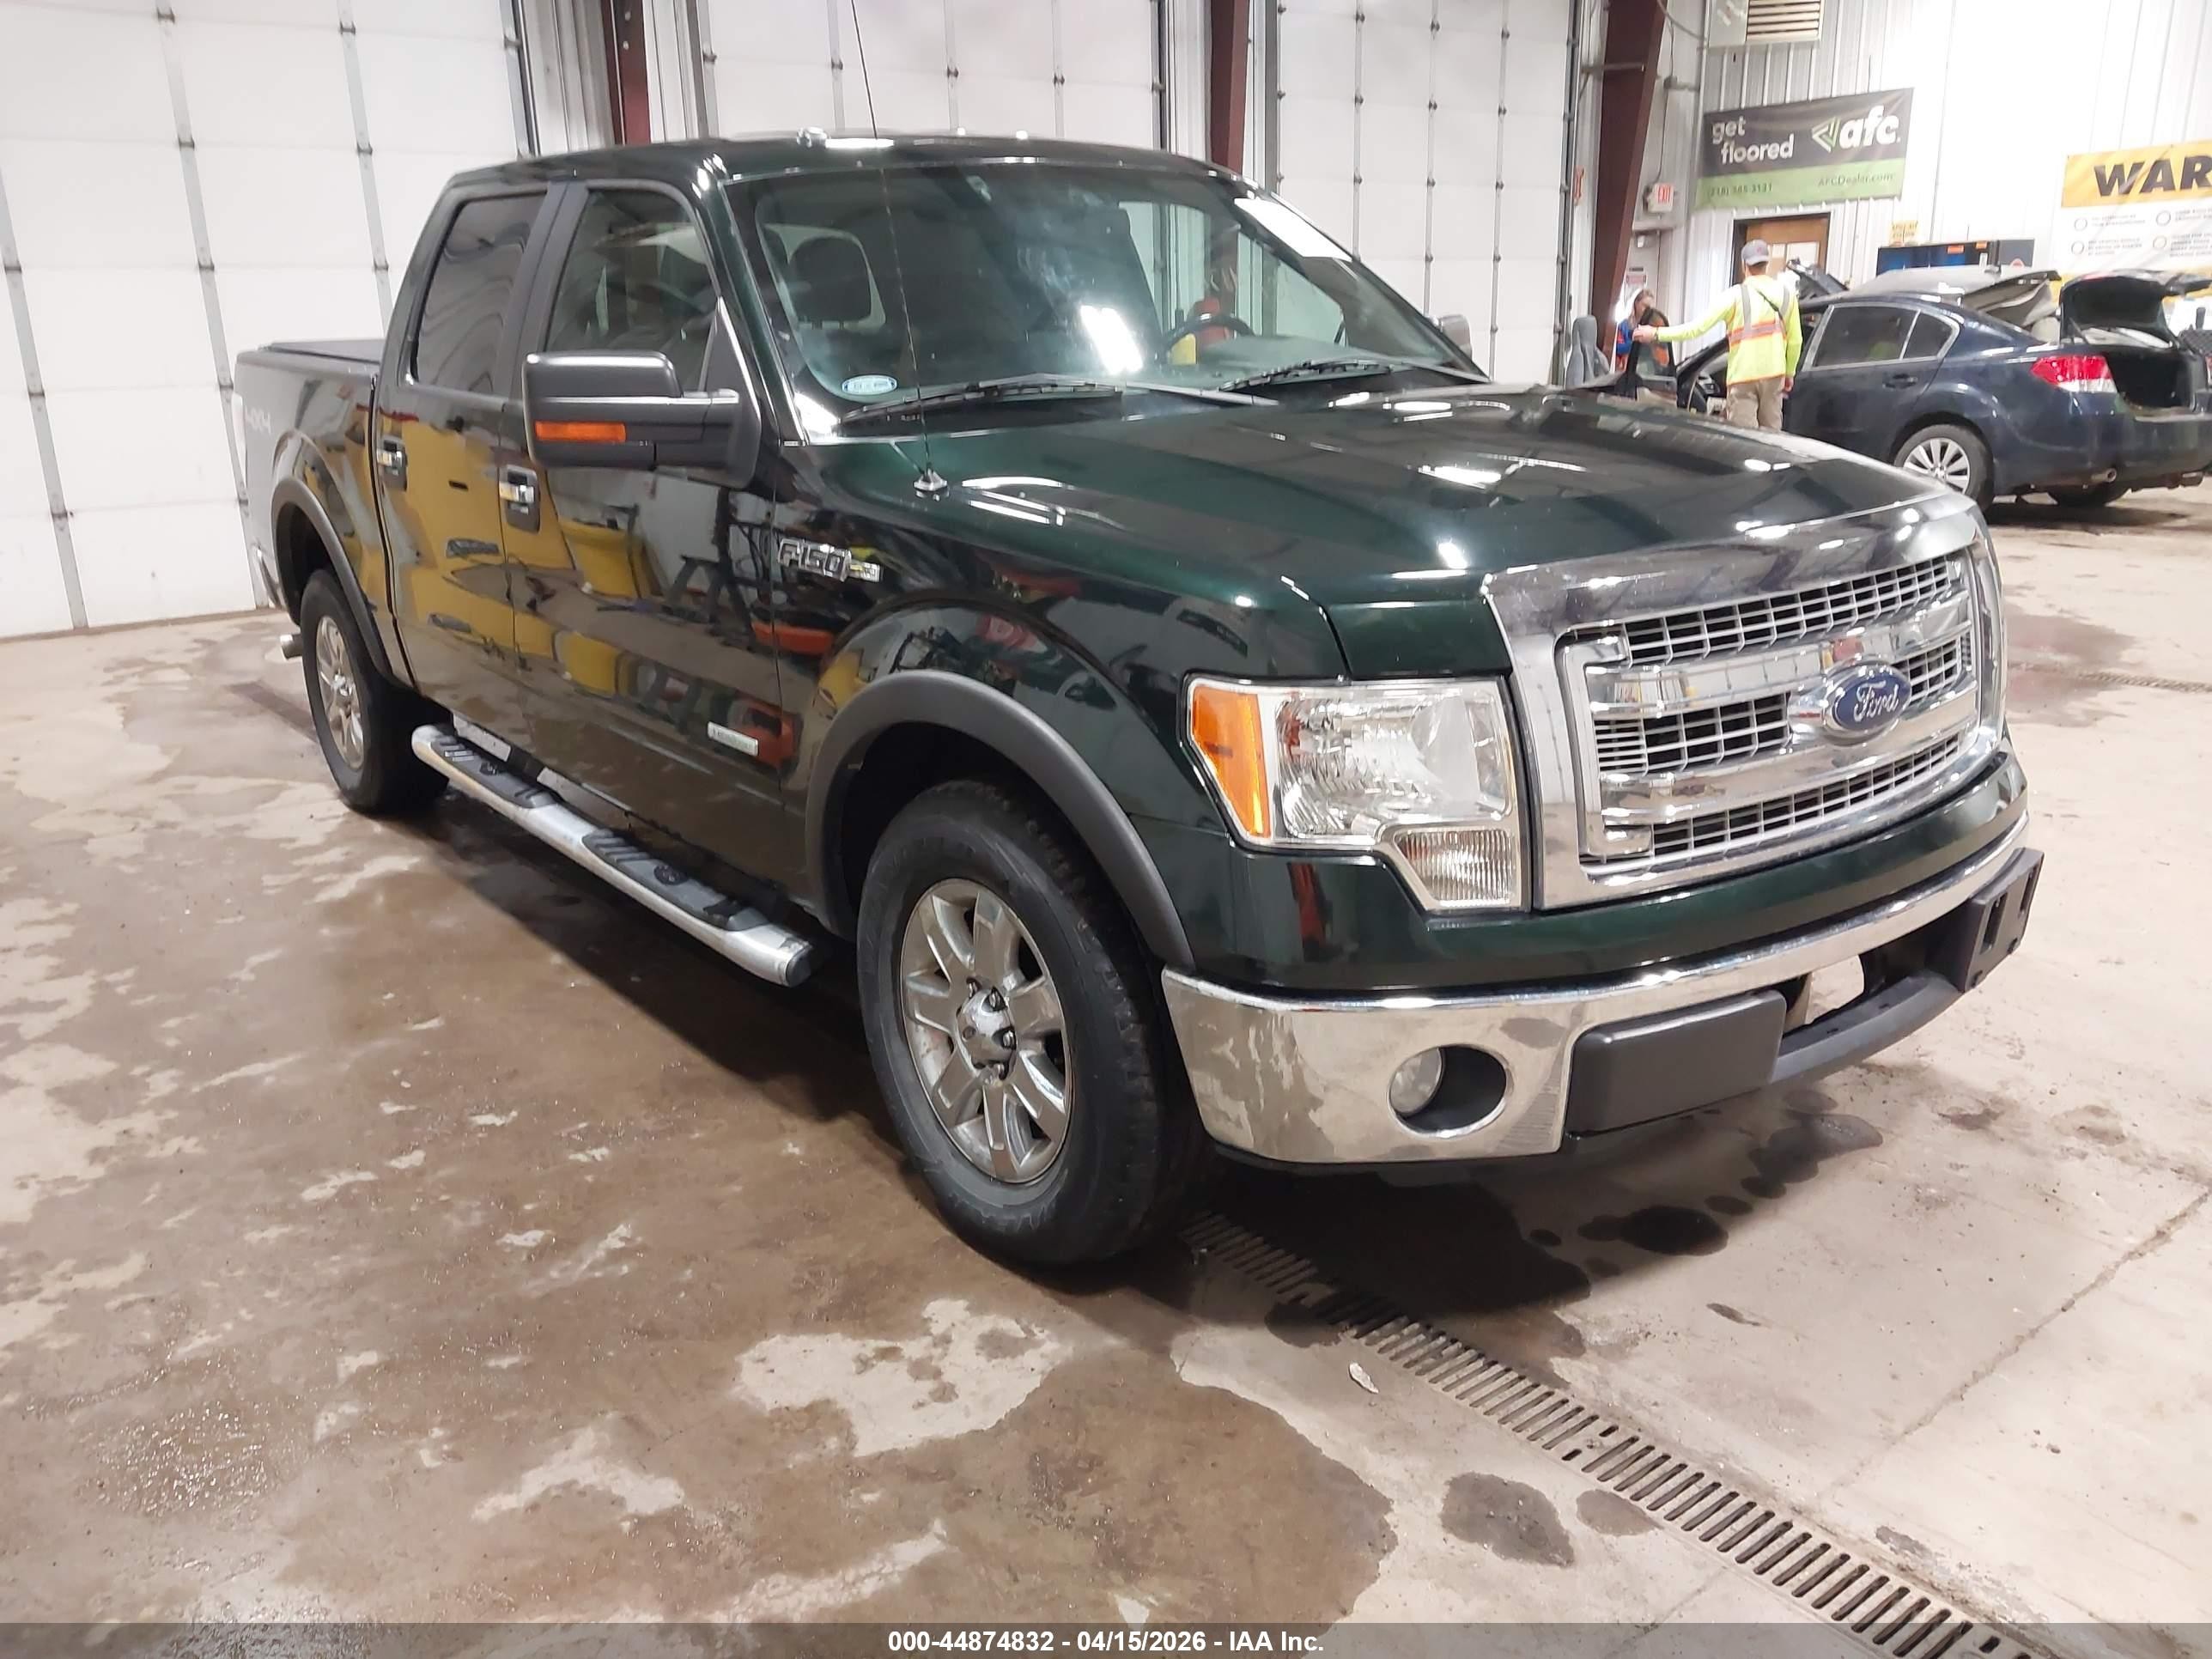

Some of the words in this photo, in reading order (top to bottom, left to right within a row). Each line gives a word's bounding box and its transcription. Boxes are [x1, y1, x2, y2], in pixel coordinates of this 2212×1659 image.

[1712, 116, 1746, 144] get
[1720, 133, 1795, 165] floored
[1853, 680, 1899, 722] Ford
